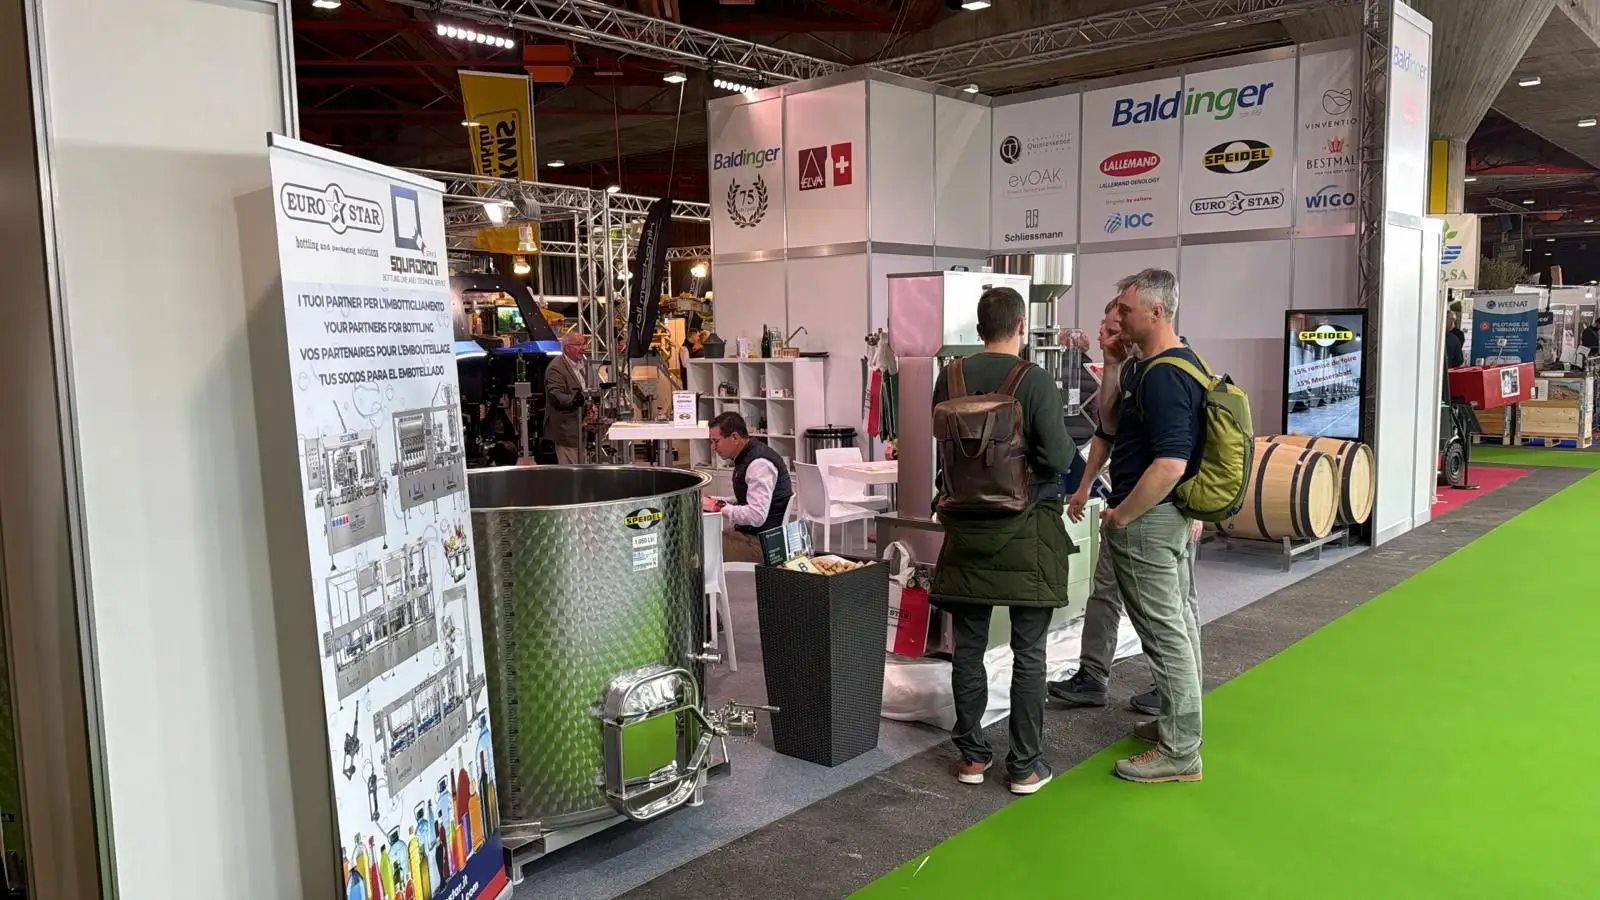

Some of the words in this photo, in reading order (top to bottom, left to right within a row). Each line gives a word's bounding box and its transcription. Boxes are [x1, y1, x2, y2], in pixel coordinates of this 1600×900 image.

[1112, 82, 1274, 128] Baldinger
[713, 147, 780, 170] Baldinger
[1103, 156, 1158, 171] LALLEMAND
[1204, 149, 1270, 165] SPEIDEL
[1008, 167, 1062, 187] evOAK
[1099, 180, 1129, 189] LALLEMAND
[740, 189, 755, 206] 75
[1194, 200, 1226, 212] EURO
[1247, 195, 1280, 207] STAR
[1306, 193, 1355, 208] WIGO
[287, 192, 326, 216] EURO
[349, 205, 381, 226] STAR
[1124, 212, 1154, 228] IOC
[1004, 231, 1063, 242] Schliessmann
[298, 294, 301, 307] I
[303, 295, 324, 308] TUOI
[326, 295, 362, 309] PARTNER
[364, 297, 379, 309] PER
[380, 298, 445, 312] L'IMBOTTIGLIAMENTO
[324, 321, 348, 333] YOUR
[349, 321, 387, 333] PARTNERS
[388, 322, 402, 333] FOR
[402, 322, 434, 333] BOTTLING
[300, 348, 320, 360] VOS
[321, 346, 375, 360] PARTENAIRES
[376, 345, 397, 357] POUR
[398, 343, 450, 356] L'EMBOUTEILLAGE
[319, 373, 337, 386] TUS
[338, 370, 366, 384] SOCIOS
[366, 369, 388, 383] PARA
[388, 368, 398, 380] EL
[398, 365, 445, 379] EMBOTELLADO
[626, 513, 661, 524] SPEIDEL
